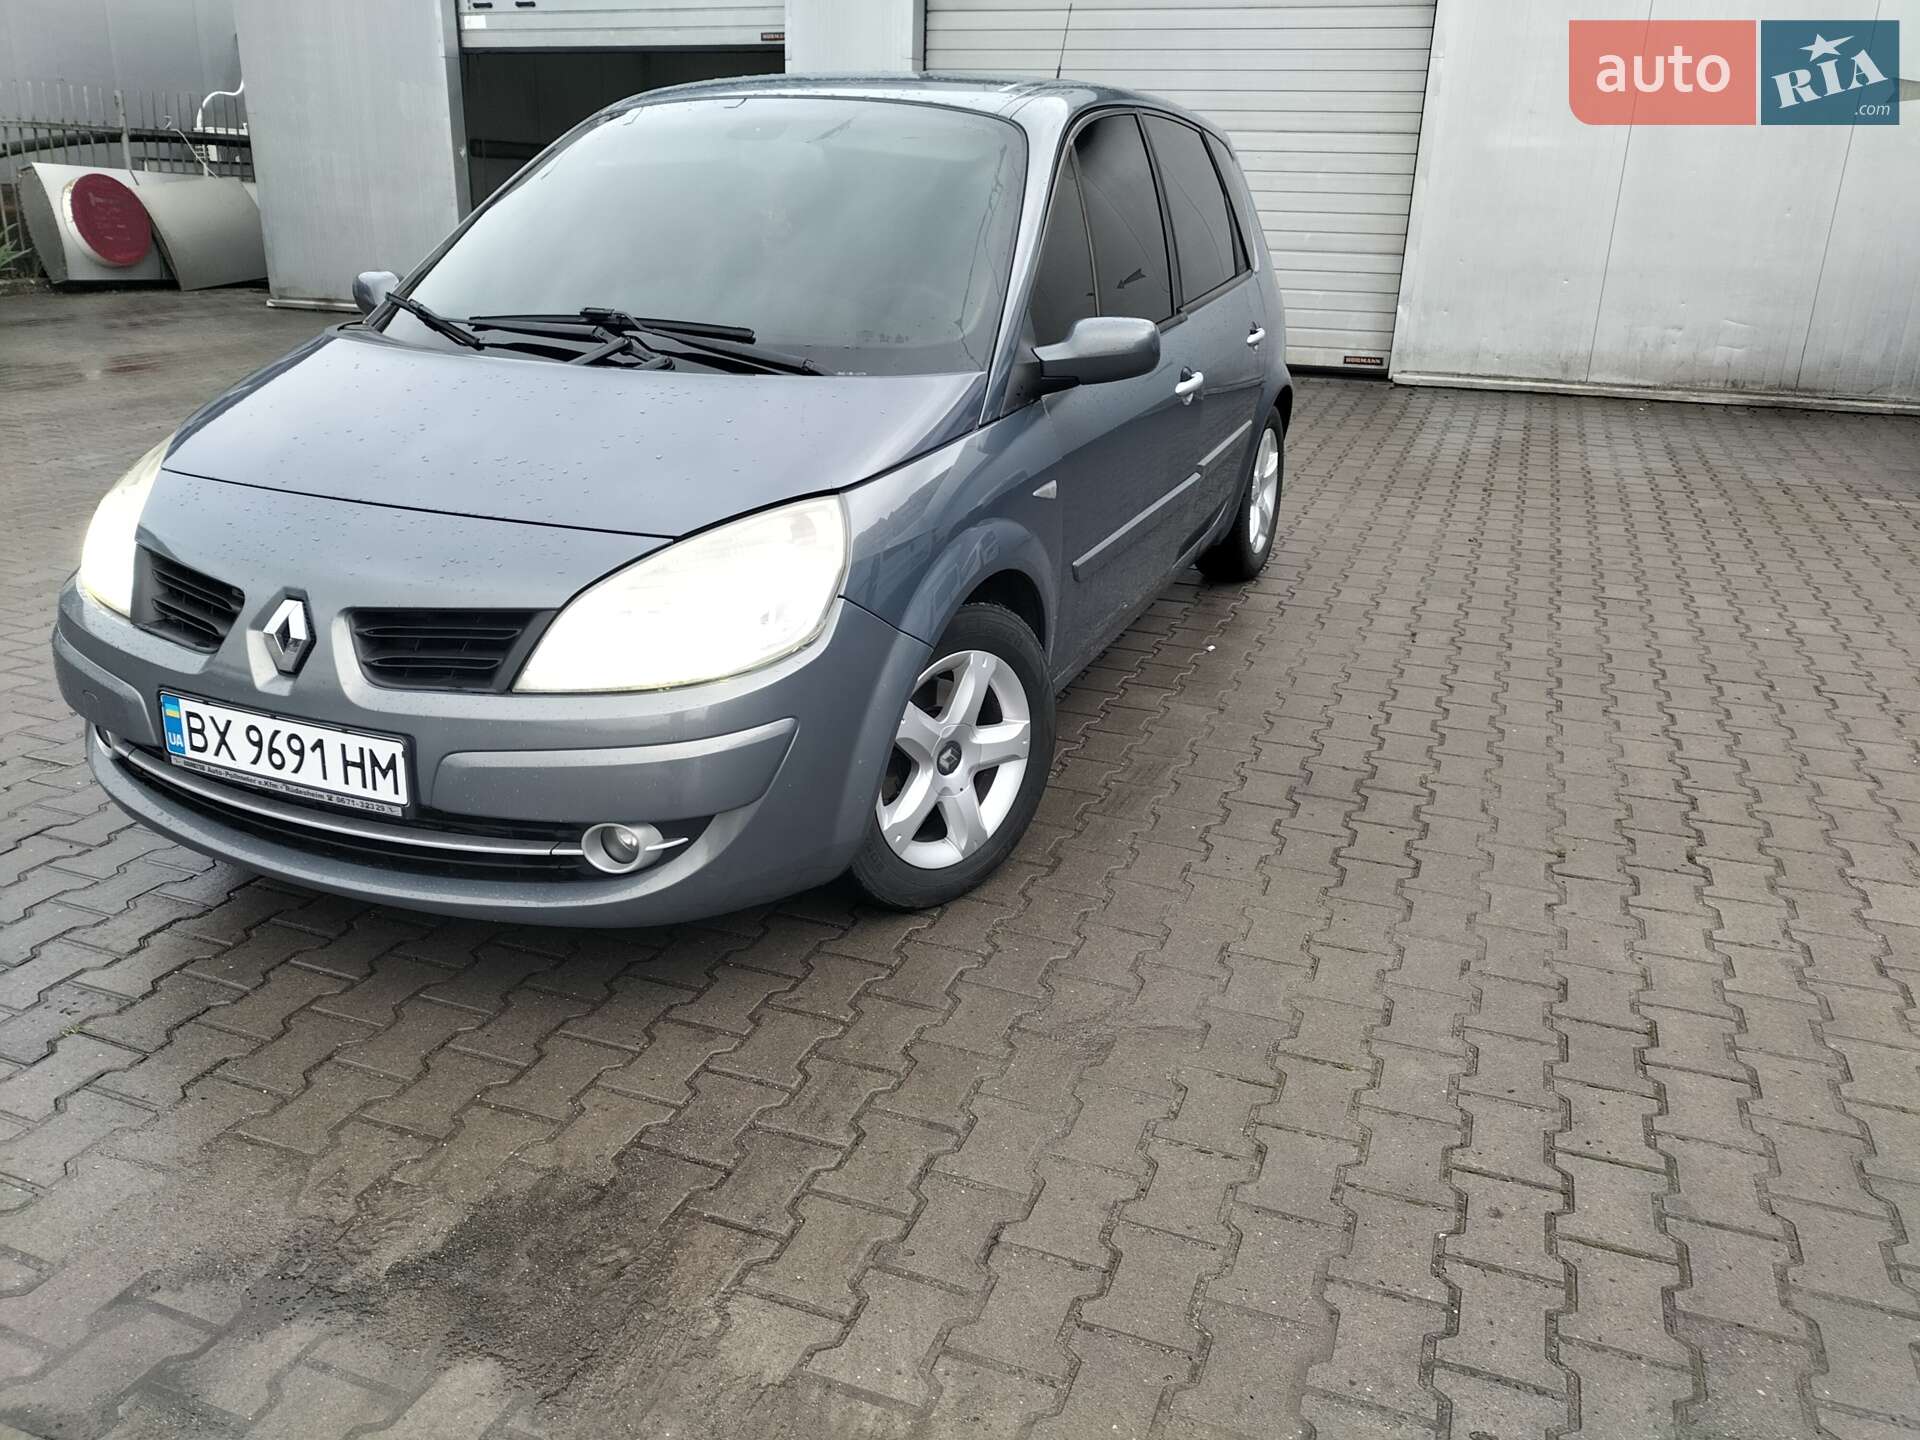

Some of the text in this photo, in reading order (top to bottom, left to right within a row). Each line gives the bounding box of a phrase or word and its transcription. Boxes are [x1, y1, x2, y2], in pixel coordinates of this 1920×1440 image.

[168, 732, 184, 748] UA
[185, 710, 400, 795] BX 9691 HM
